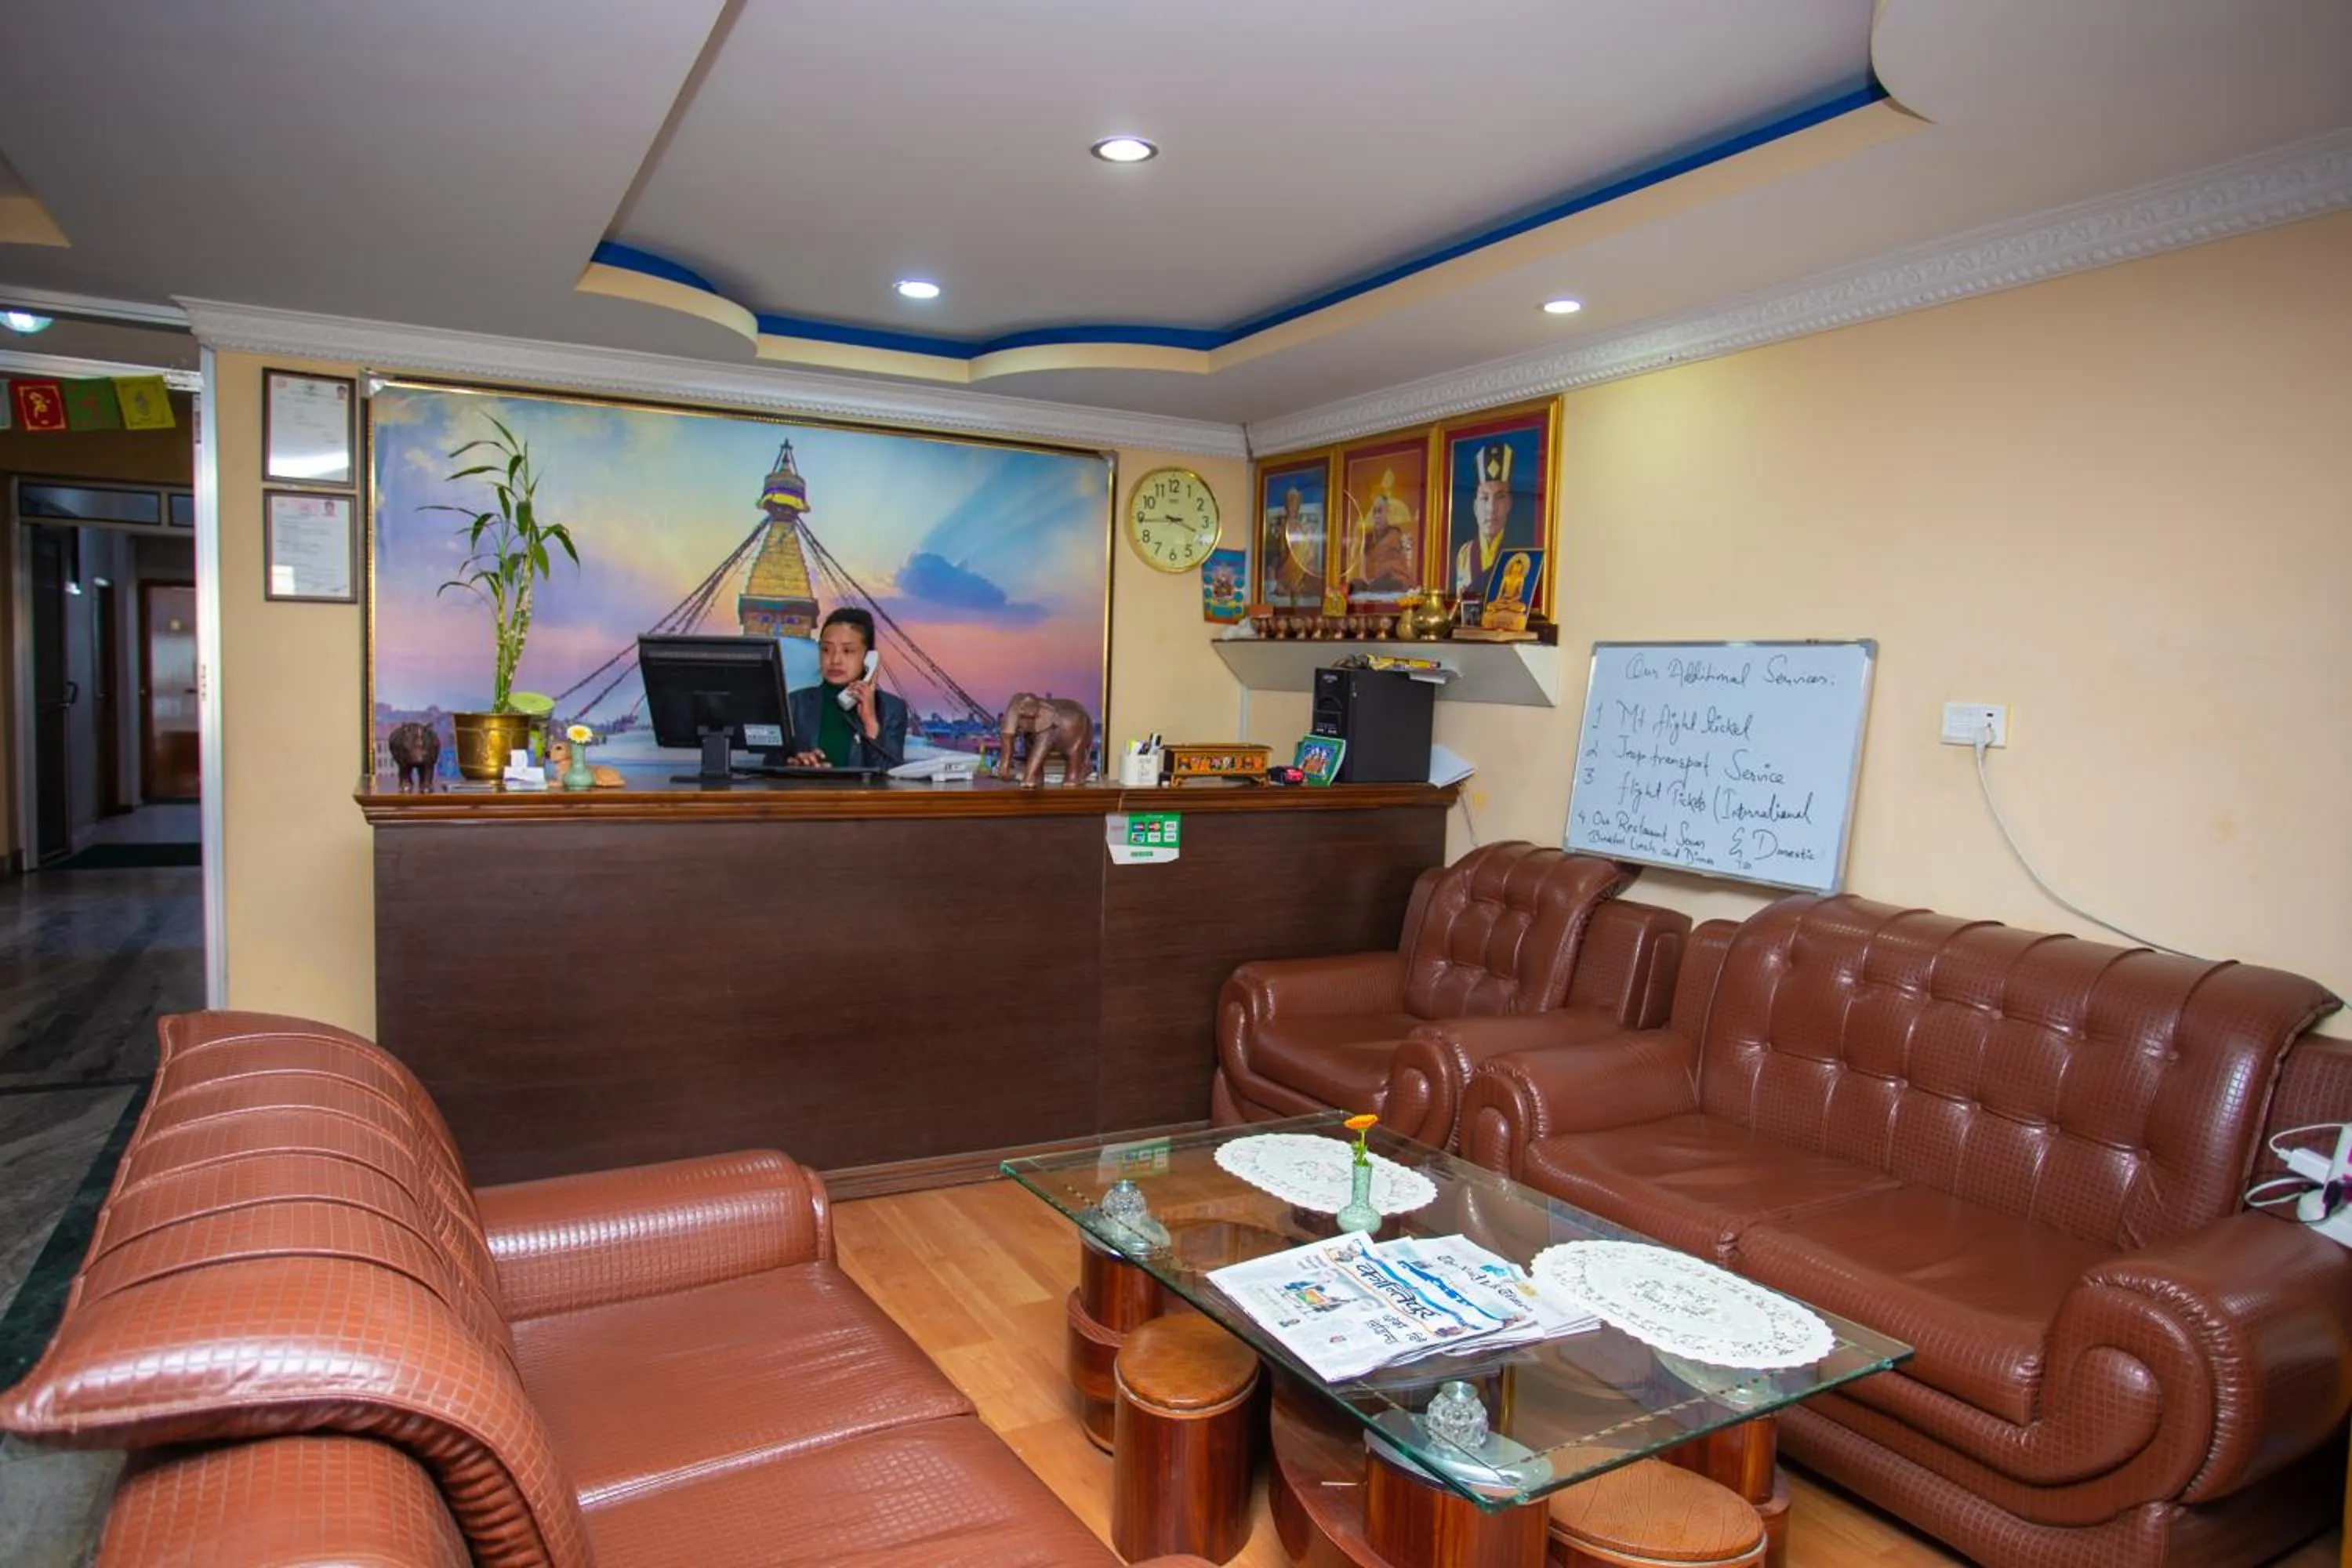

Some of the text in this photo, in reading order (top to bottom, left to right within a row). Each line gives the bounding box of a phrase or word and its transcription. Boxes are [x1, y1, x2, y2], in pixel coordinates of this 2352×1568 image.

[1155, 483, 1165, 498] 11
[1168, 479, 1180, 493] 12
[1187, 485, 1192, 498] 1
[1142, 495, 1156, 510] 10
[1196, 498, 1204, 511] 2
[1202, 516, 1209, 528] 3
[1142, 529, 1150, 543] 8
[1154, 542, 1162, 555] 7
[1169, 547, 1177, 561] 6
[1185, 545, 1192, 557] 5
[1625, 652, 1659, 680] Our
[1668, 658, 1751, 687] Additional
[1725, 749, 1785, 784] Service
[1584, 768, 1595, 785] 3
